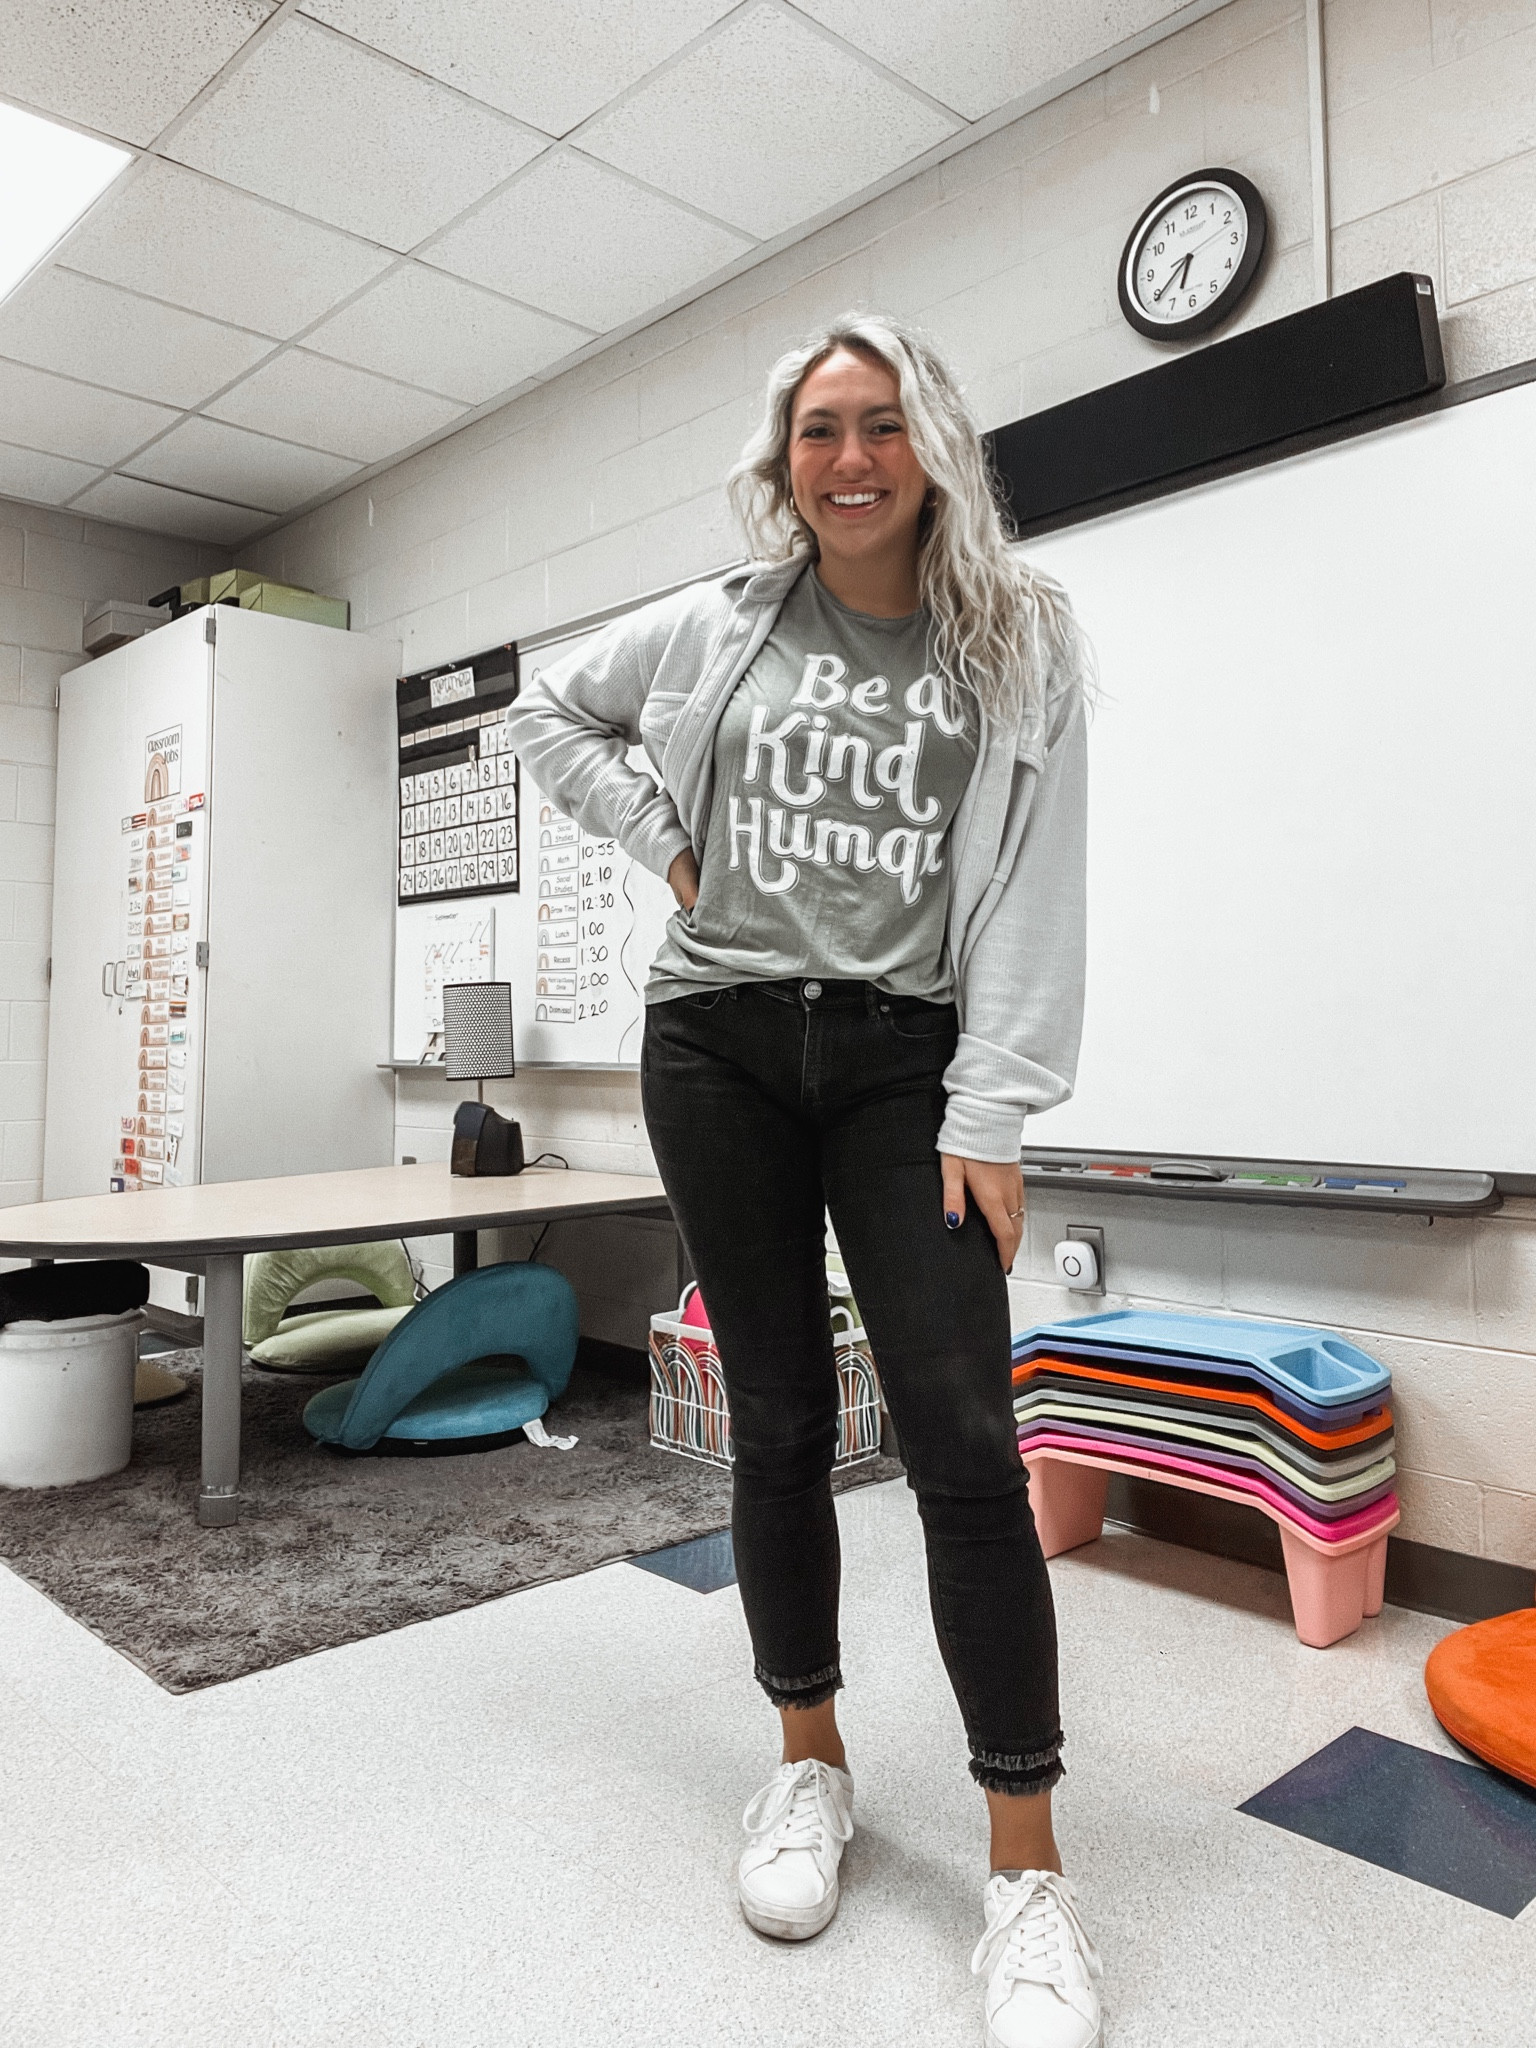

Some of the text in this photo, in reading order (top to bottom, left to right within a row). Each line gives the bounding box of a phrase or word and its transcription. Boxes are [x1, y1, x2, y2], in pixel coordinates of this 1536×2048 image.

[1184, 204, 1198, 220] 12
[1209, 202, 1215, 215] 1
[1223, 210, 1232, 225] 2
[1165, 221, 1176, 236] 11
[1230, 231, 1239, 245] 3
[1152, 241, 1165, 257] 10
[1224, 257, 1233, 270] 4
[1146, 268, 1155, 282] 9
[1209, 279, 1218, 294] 5
[1168, 297, 1176, 311] 7
[1188, 294, 1197, 308] 6
[790, 653, 966, 738] Be a
[161, 748, 179, 765] Jobs
[742, 704, 942, 825] Kind
[405, 759, 510, 800] 3 4 5 6 7 8 9
[433, 806, 441, 825] 12
[448, 803, 457, 821] 13
[466, 800, 475, 818] 14
[483, 796, 492, 815] 15
[500, 792, 512, 811] 16
[433, 837, 442, 856] 19
[448, 833, 459, 854] 20
[464, 832, 474, 851] 21
[480, 828, 494, 848] 22
[499, 824, 513, 845] 23
[581, 840, 616, 860] 10:55
[403, 855, 514, 891] 24 25 26 27 28 29 30
[581, 866, 612, 888] 12:10
[564, 905, 577, 913] Time
[582, 893, 615, 911] 12:30
[555, 930, 570, 939] Lunch
[553, 955, 571, 964] Recess
[580, 945, 609, 966] 1:30
[578, 999, 609, 1021] 2:20
